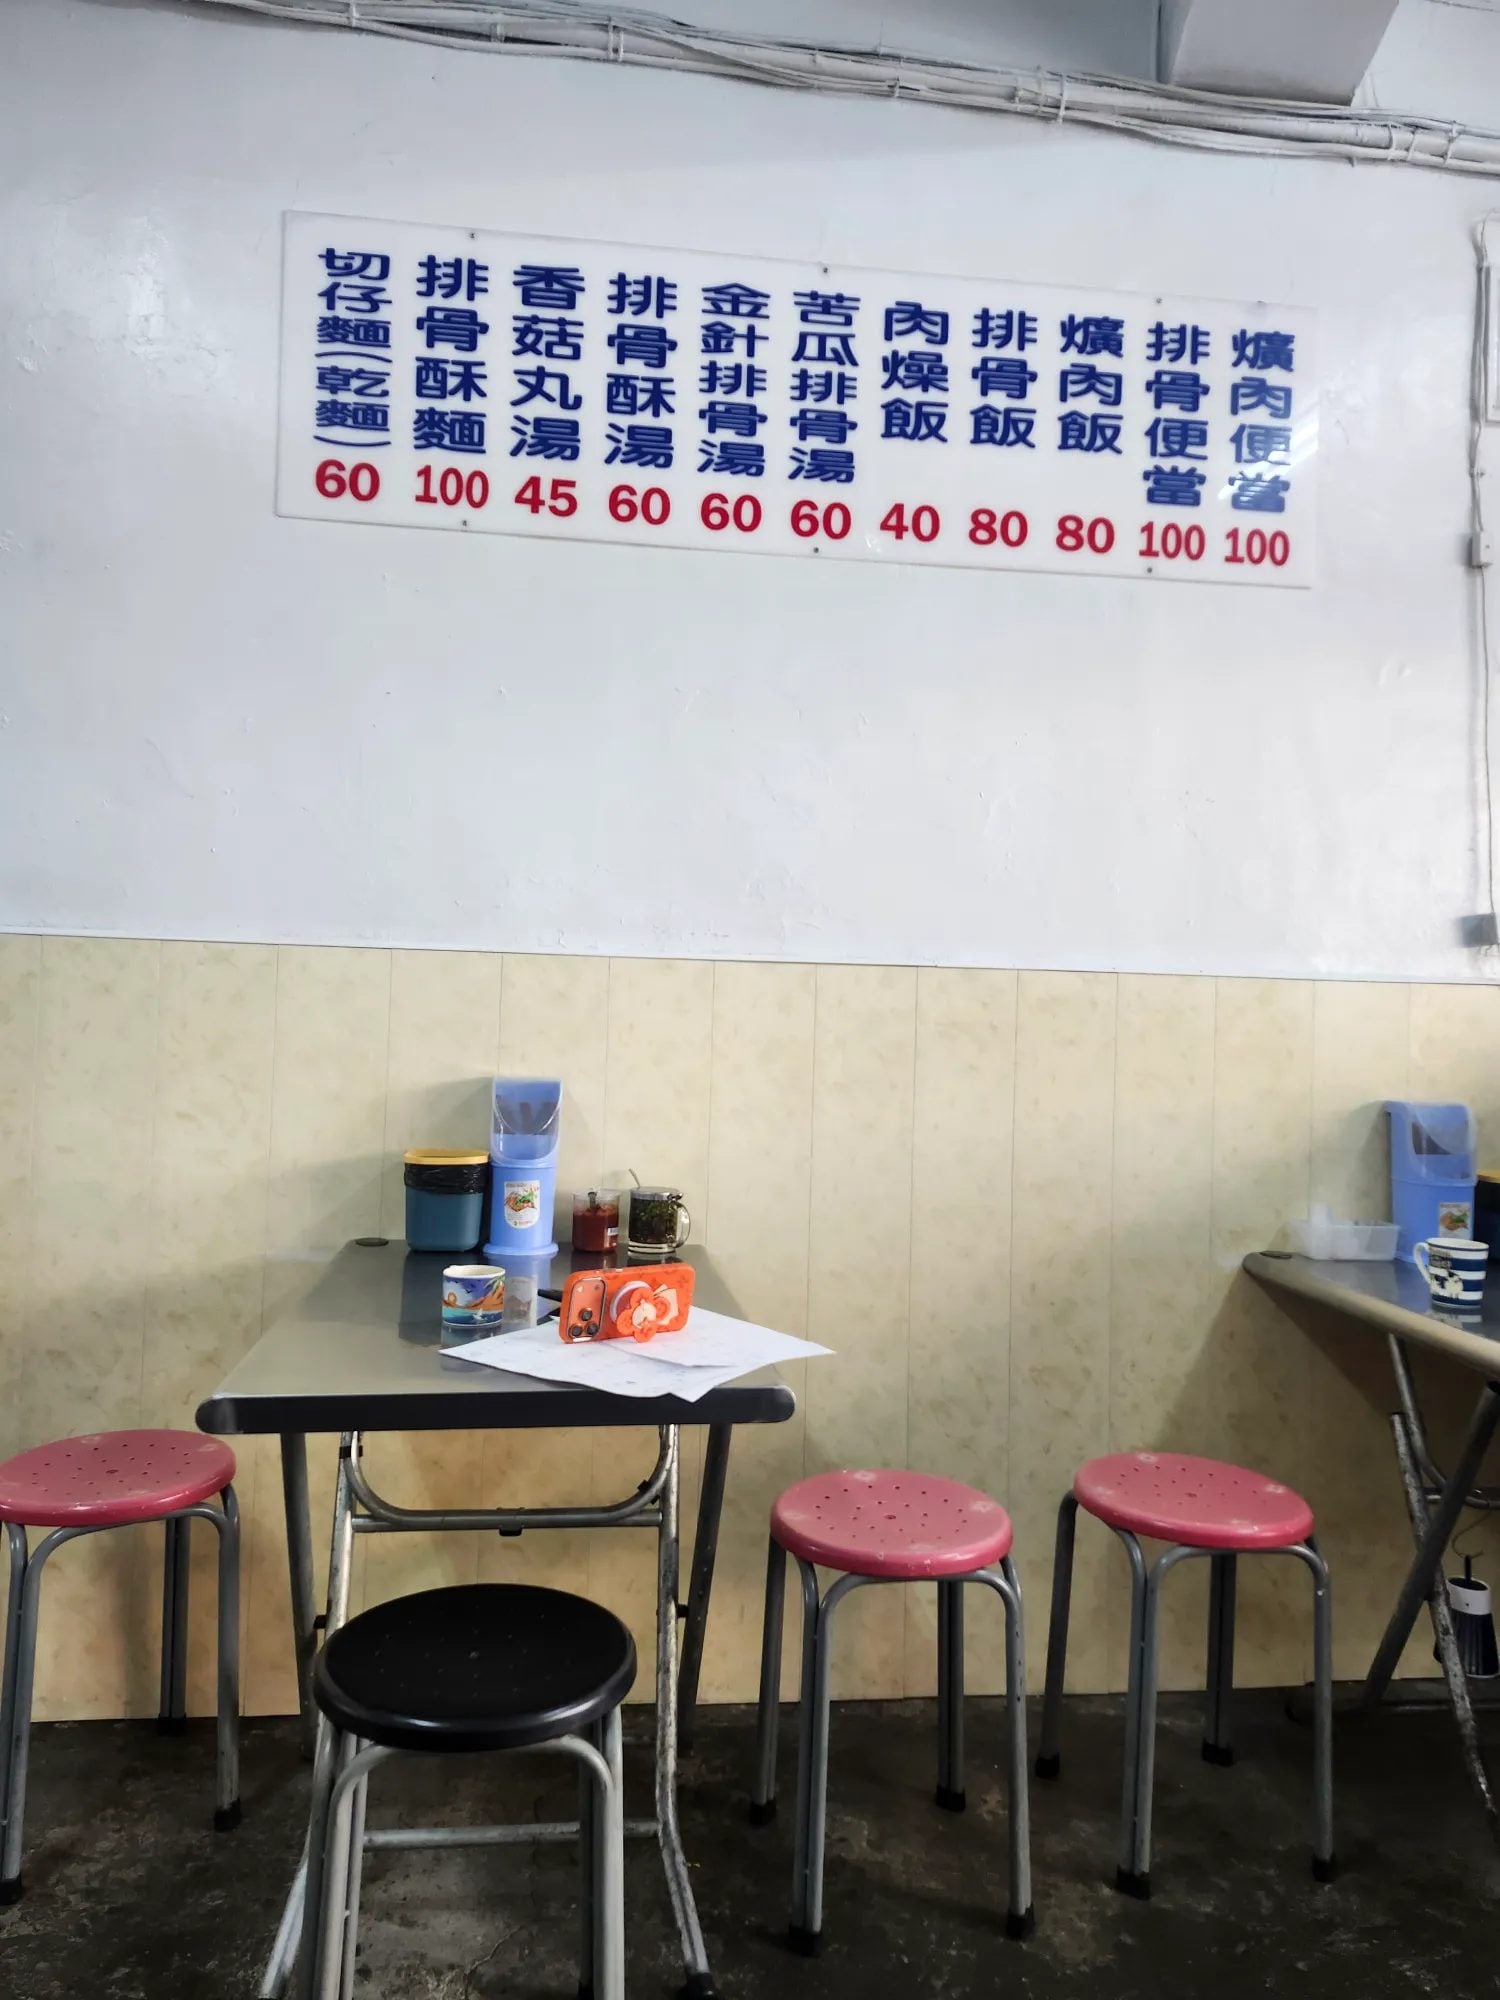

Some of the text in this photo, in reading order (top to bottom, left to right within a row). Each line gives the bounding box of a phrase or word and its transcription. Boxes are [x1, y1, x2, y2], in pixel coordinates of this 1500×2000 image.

[413, 255, 490, 455] 排骨酥麵
[510, 265, 585, 461] 香菇丸湯
[604, 272, 678, 469] 排骨酥湯
[881, 301, 949, 443] 肉燥飯
[697, 283, 771, 477] 金針排骨湯
[789, 290, 859, 484] 苦瓜排骨湯
[970, 308, 1038, 448] 排骨飯
[1143, 321, 1210, 507] 排骨便當
[315, 460, 380, 501] 60
[416, 465, 489, 509] 100
[515, 476, 578, 517] 45
[609, 484, 671, 525] 60
[700, 493, 762, 533] 60
[791, 500, 852, 540] 60
[880, 503, 941, 542] 40
[969, 508, 1028, 548] 80
[1056, 515, 1115, 554] 80
[1140, 523, 1205, 560] 100
[1226, 529, 1289, 566] 100
